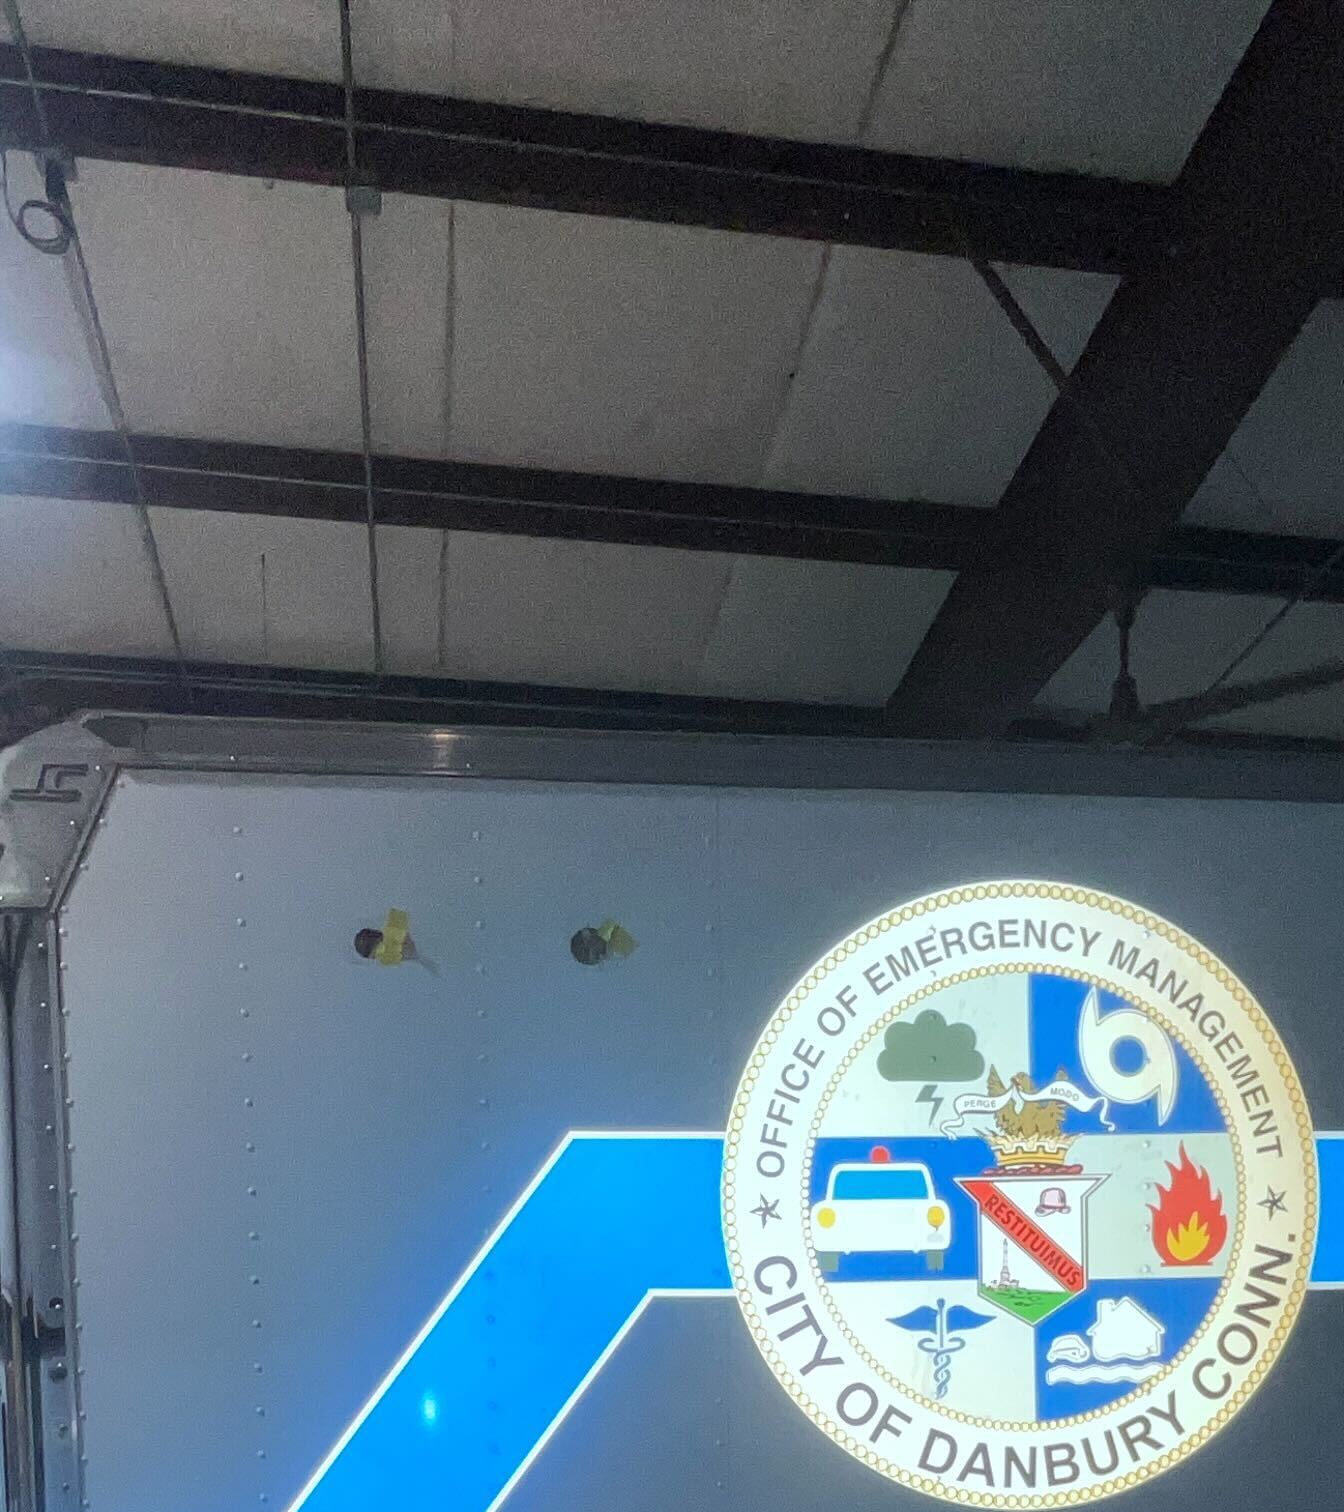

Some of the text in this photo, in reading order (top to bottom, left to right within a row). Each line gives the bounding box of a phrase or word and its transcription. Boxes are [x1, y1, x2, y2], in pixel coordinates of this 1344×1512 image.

[756, 918, 1284, 1178] OFFICE OF EMERGENCY MANAGEMENT
[1050, 1087, 1080, 1102] MODO
[984, 1193, 1082, 1287] RESTITUIMUS
[753, 1232, 1297, 1488] CITY OF DANBURY CONN.
